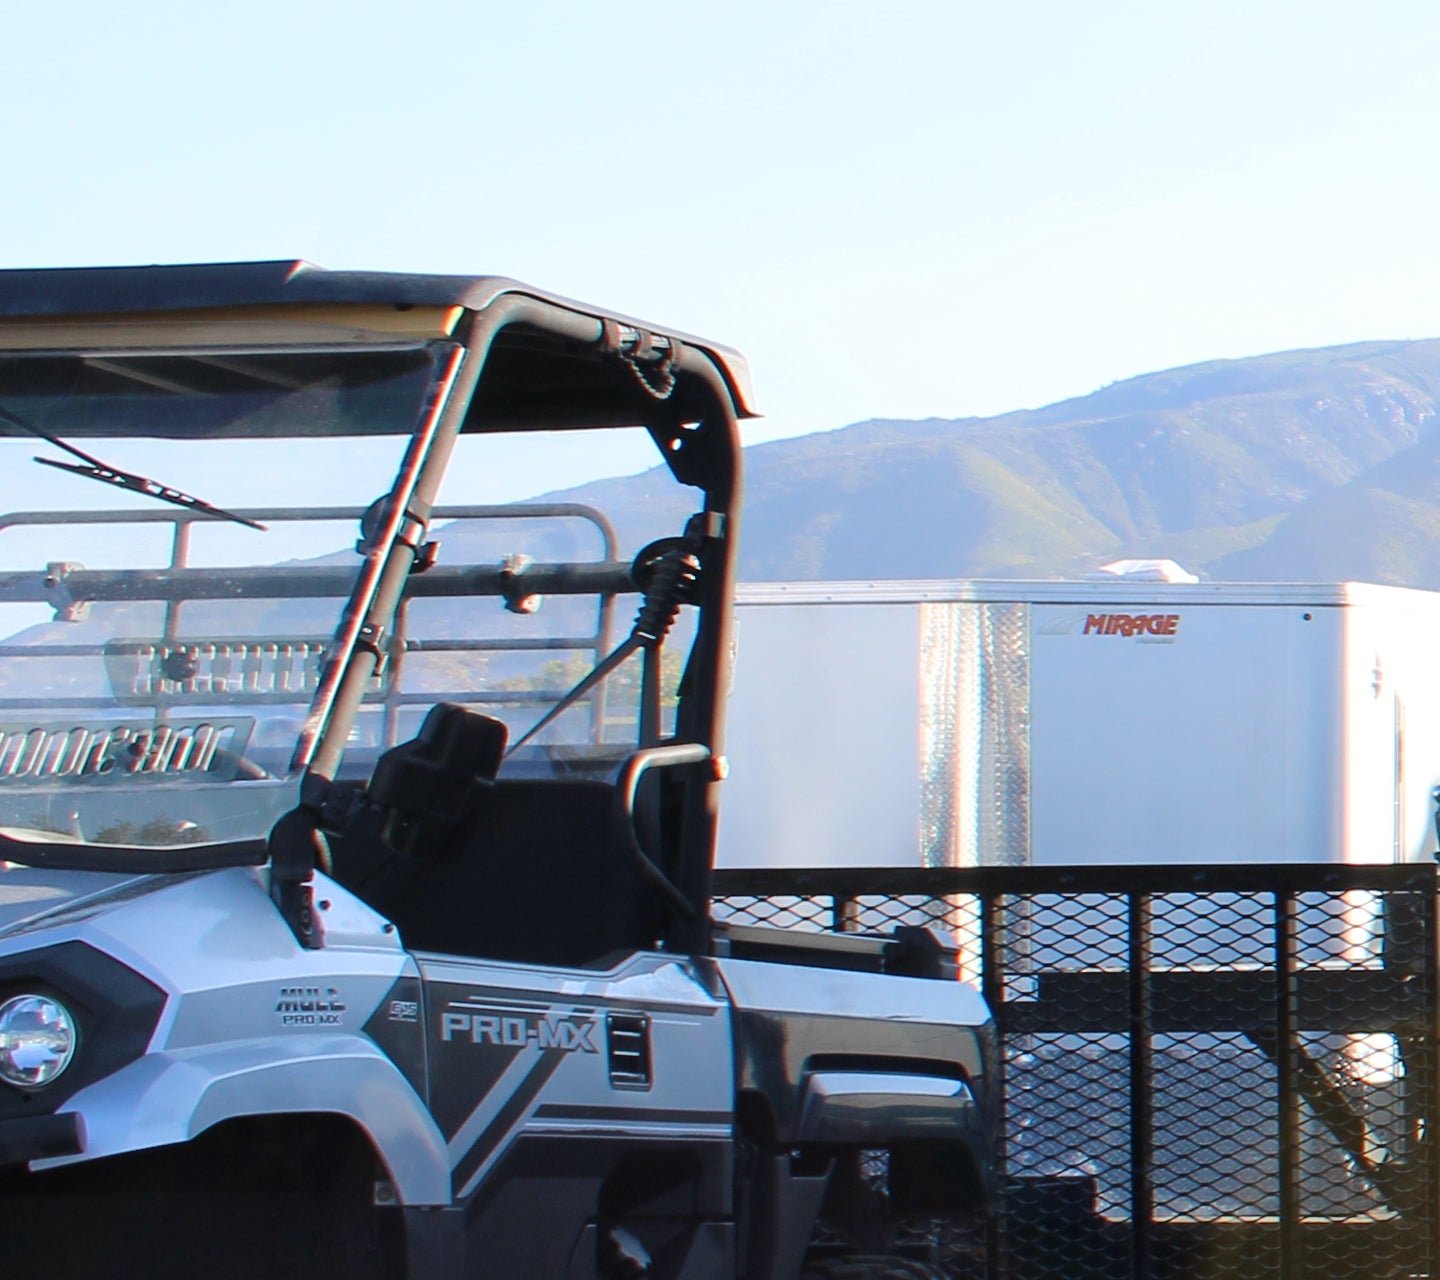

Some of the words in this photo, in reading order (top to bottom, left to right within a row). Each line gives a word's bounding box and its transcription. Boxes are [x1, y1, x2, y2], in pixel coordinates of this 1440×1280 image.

[1082, 614, 1179, 637] MIRAGE
[276, 988, 347, 1012] MULE
[442, 1013, 599, 1054] PRO-MX
